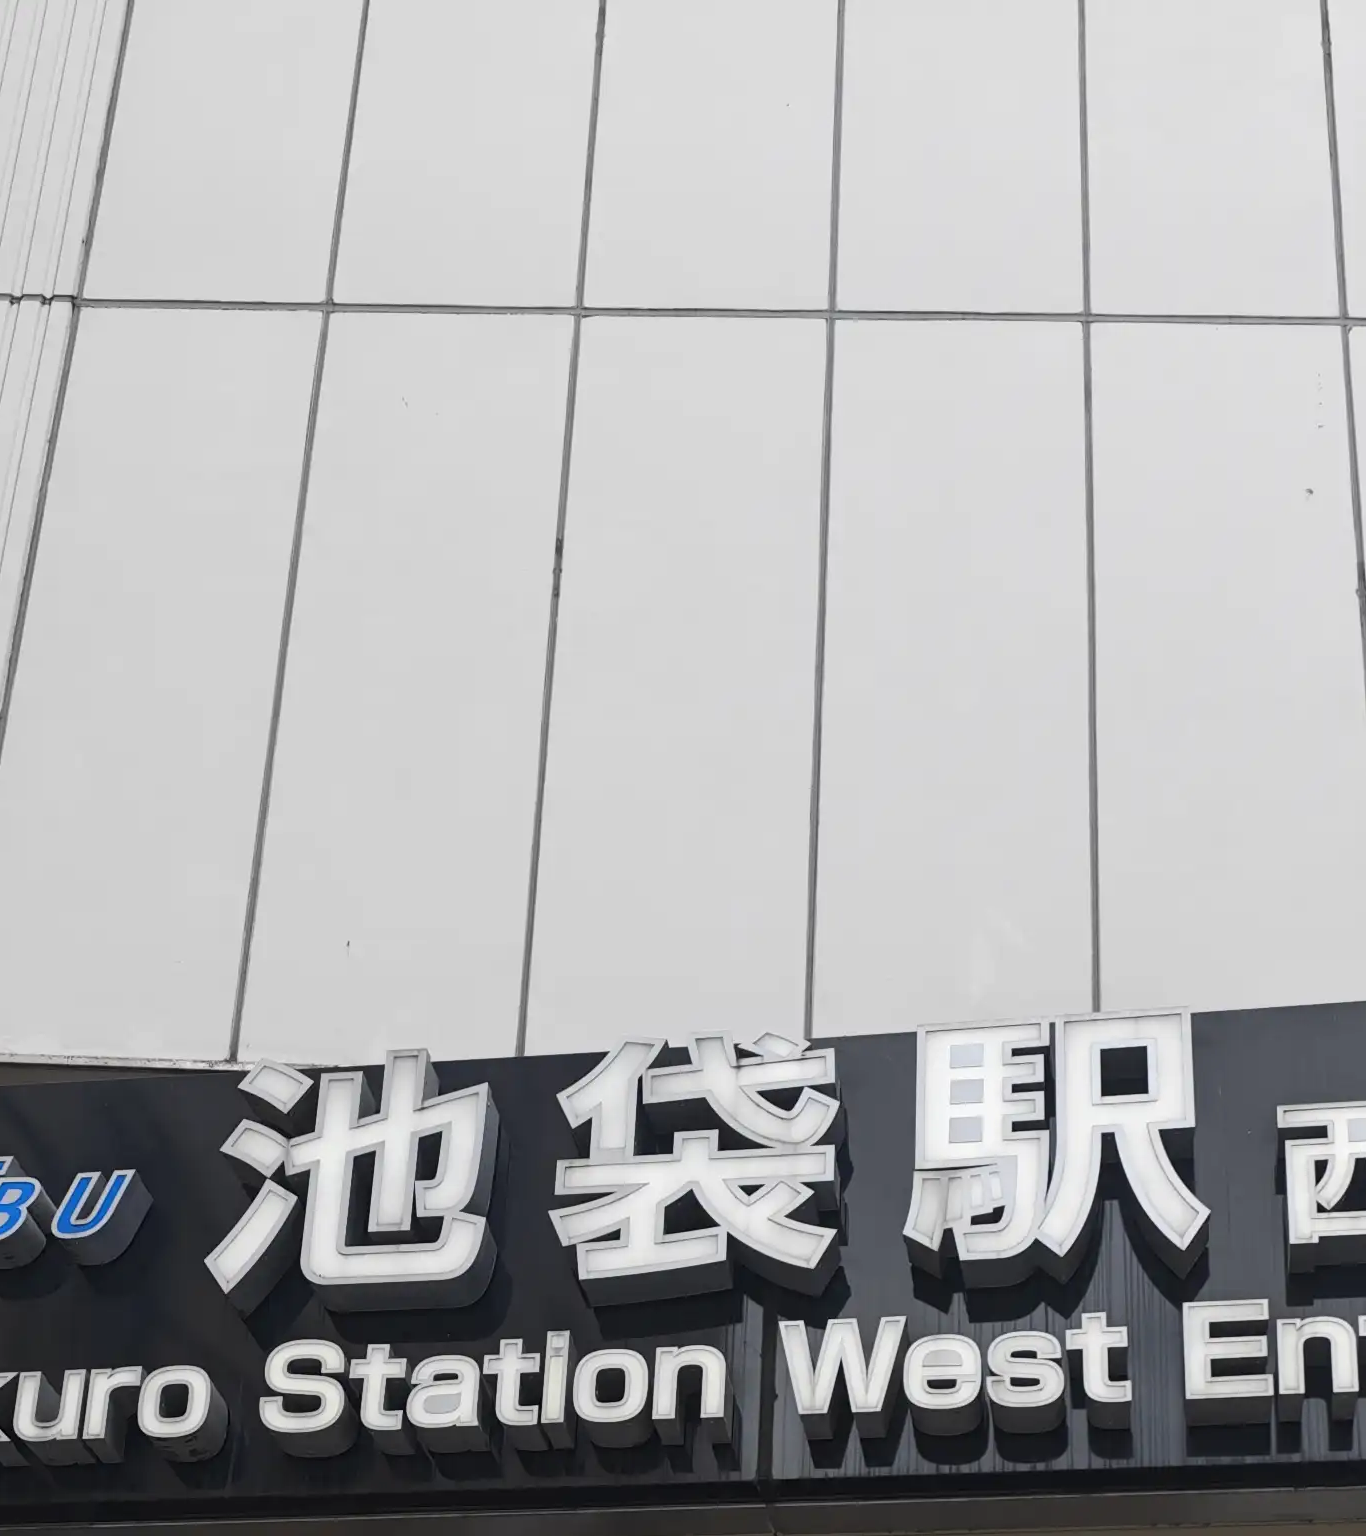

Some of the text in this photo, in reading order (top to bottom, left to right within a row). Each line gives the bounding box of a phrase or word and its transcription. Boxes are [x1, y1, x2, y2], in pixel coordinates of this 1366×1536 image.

[205, 1006, 1211, 1297] 池袋駅
[258, 1330, 727, 1433] Station
[778, 1310, 1133, 1417] West
